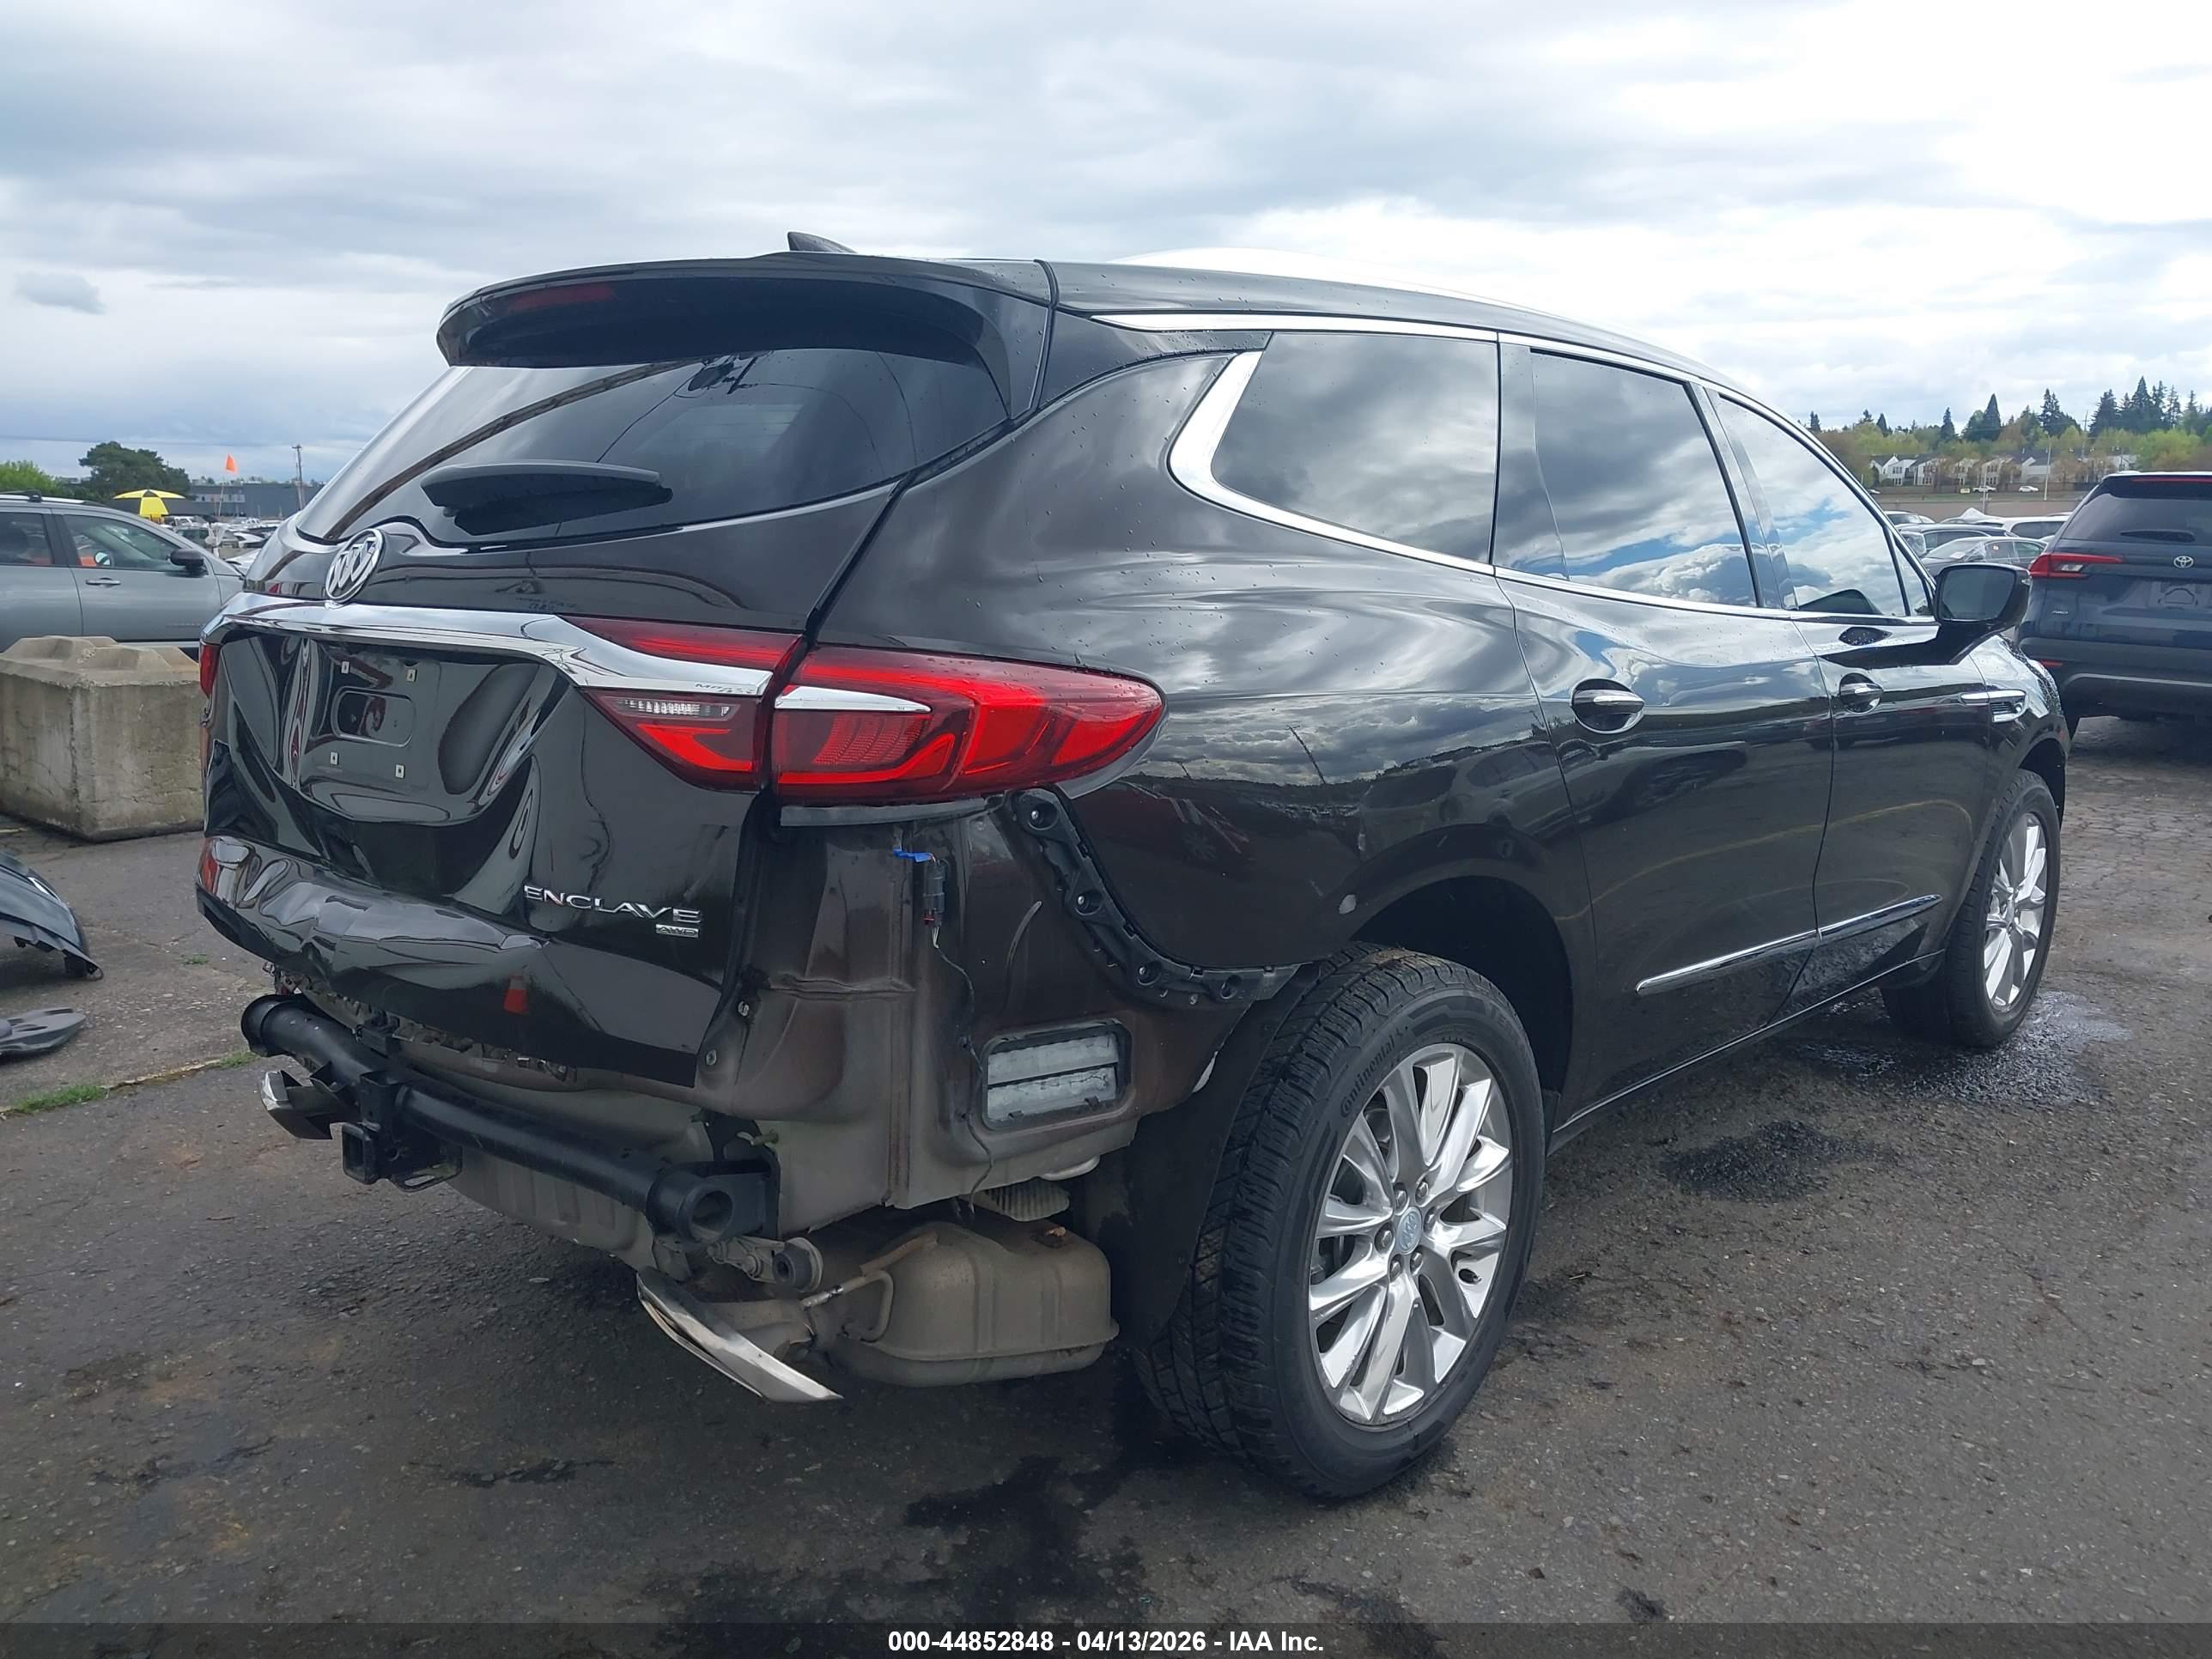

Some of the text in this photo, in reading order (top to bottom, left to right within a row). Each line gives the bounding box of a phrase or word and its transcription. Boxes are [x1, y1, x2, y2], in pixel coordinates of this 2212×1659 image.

[524, 884, 701, 924] ENCLAVE
[657, 925, 698, 938] AWD
[1340, 1034, 1396, 1118] Continental
